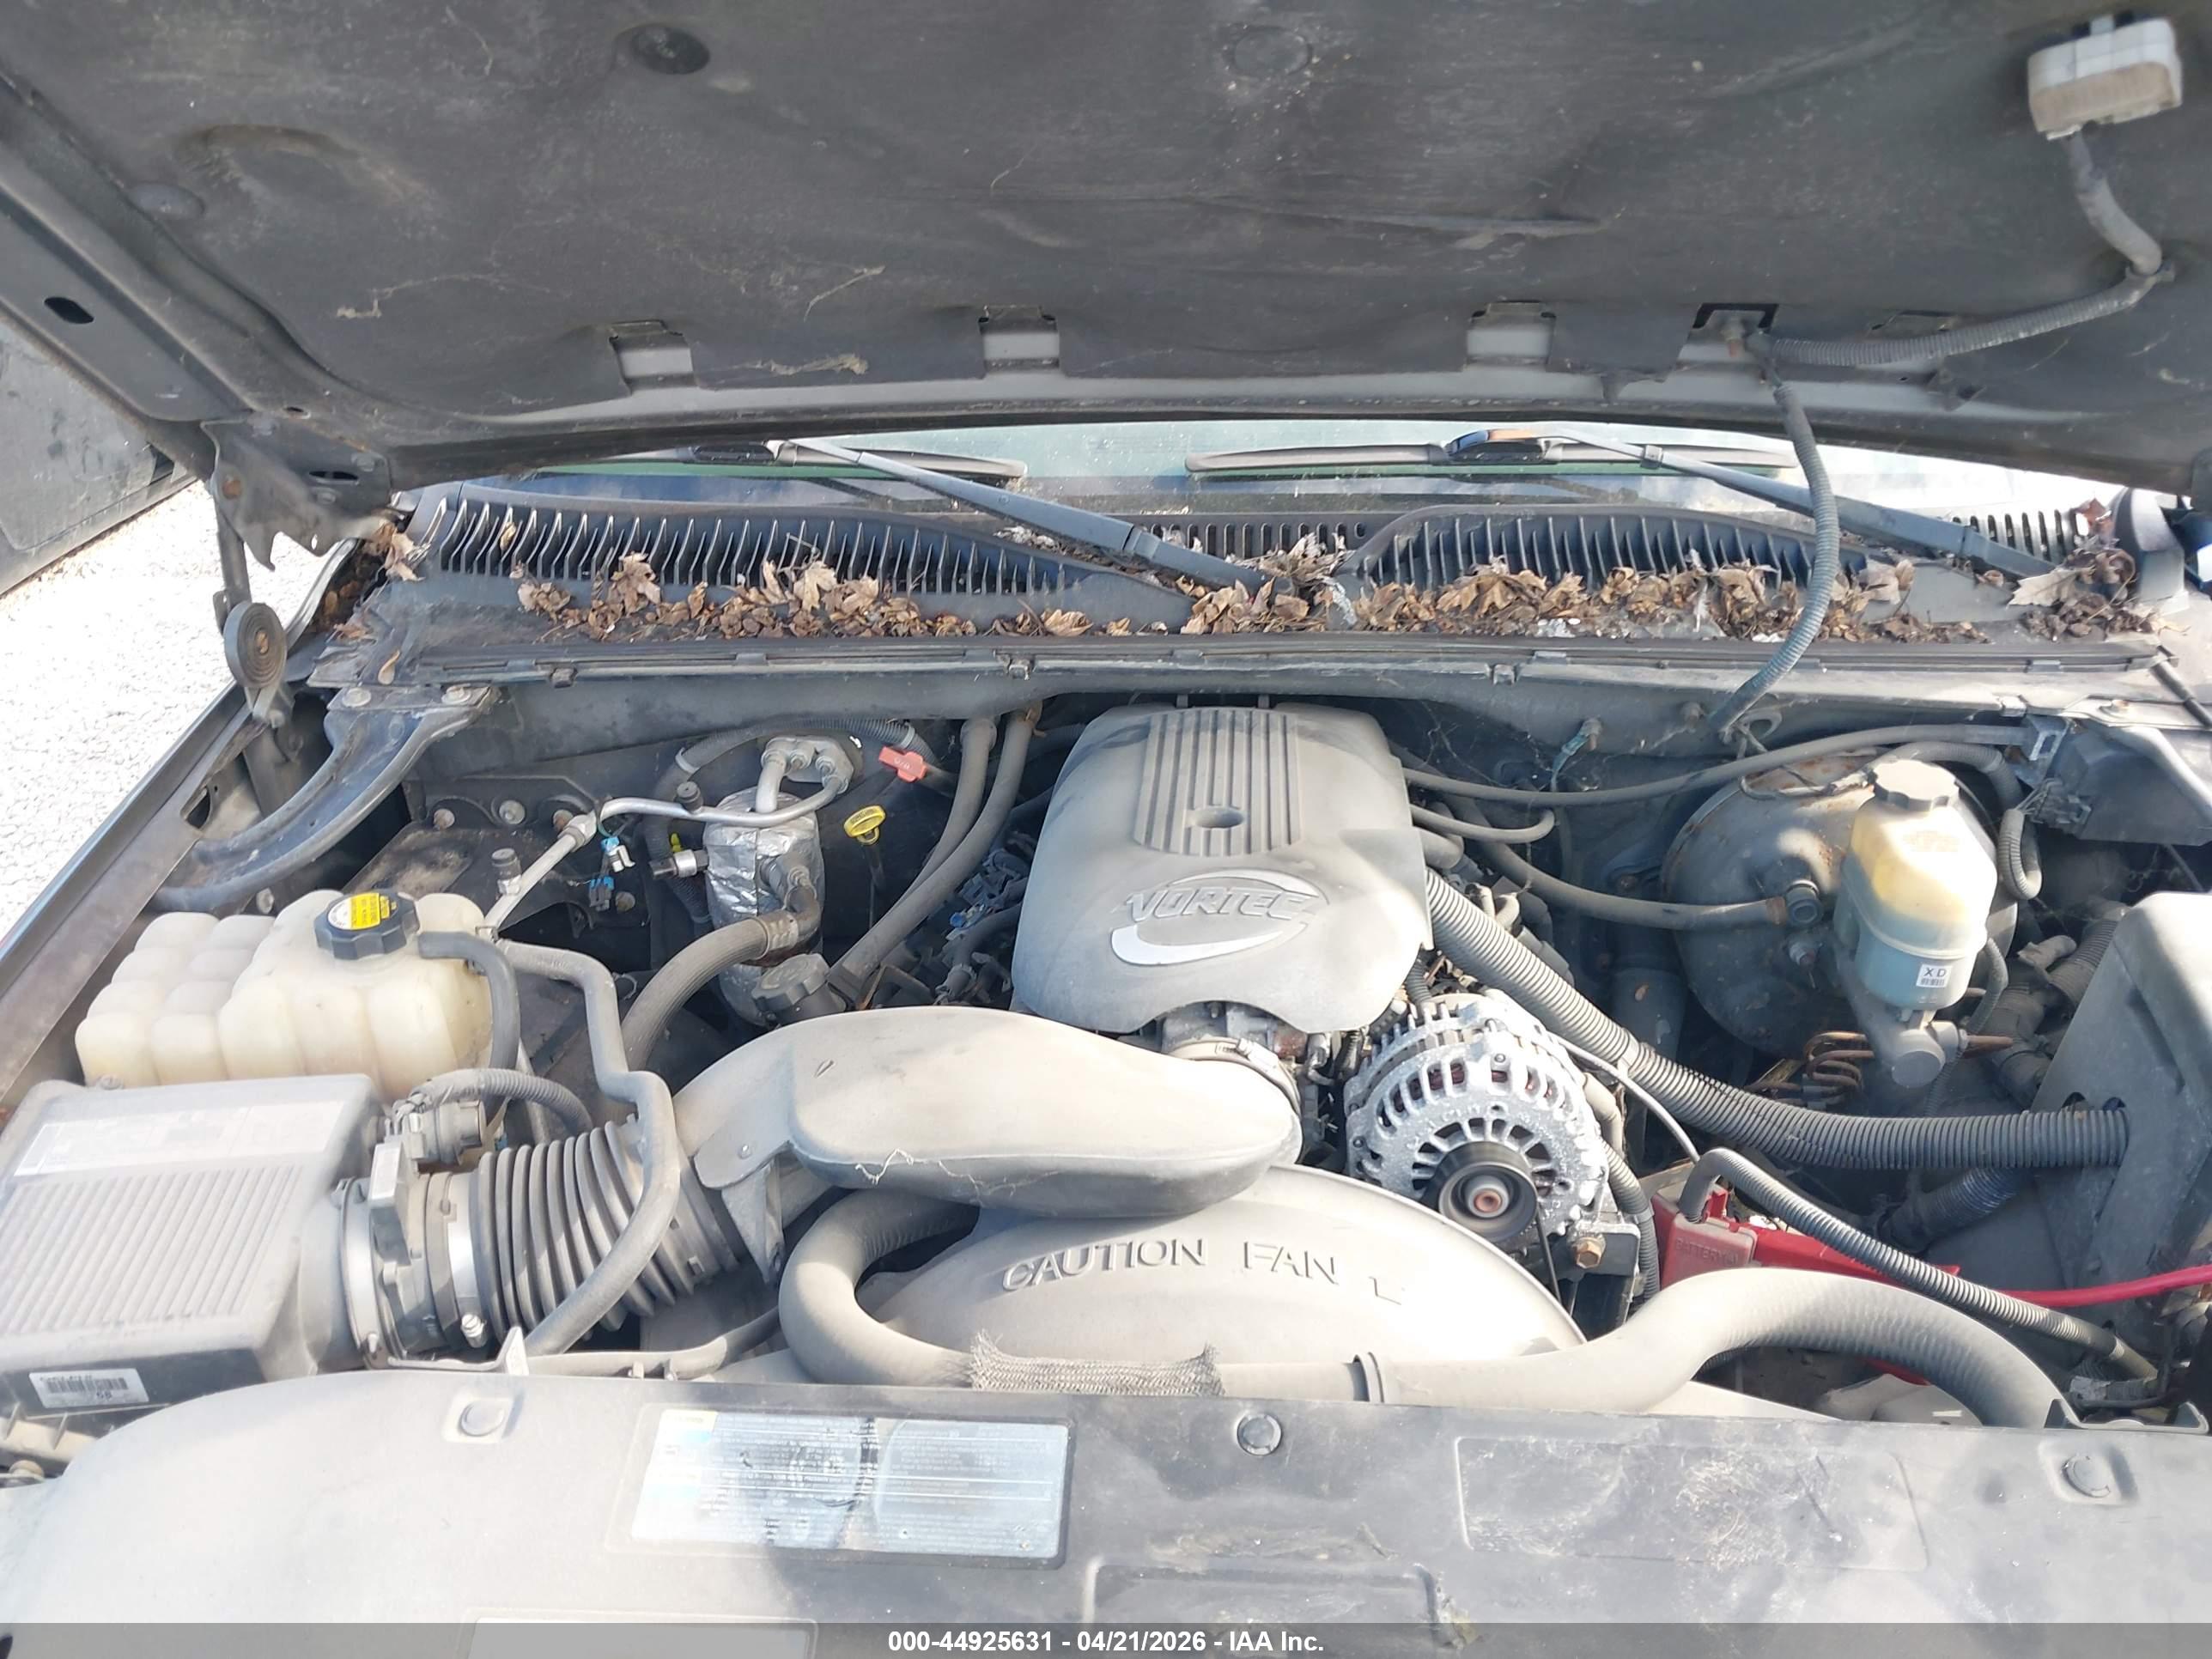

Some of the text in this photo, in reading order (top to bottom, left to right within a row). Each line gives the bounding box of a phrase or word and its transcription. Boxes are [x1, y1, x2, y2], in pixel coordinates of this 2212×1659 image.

[1126, 886, 1312, 923] VORTEC
[1002, 1238, 1207, 1291] CAUTION
[1243, 1241, 1339, 1285] FAN
